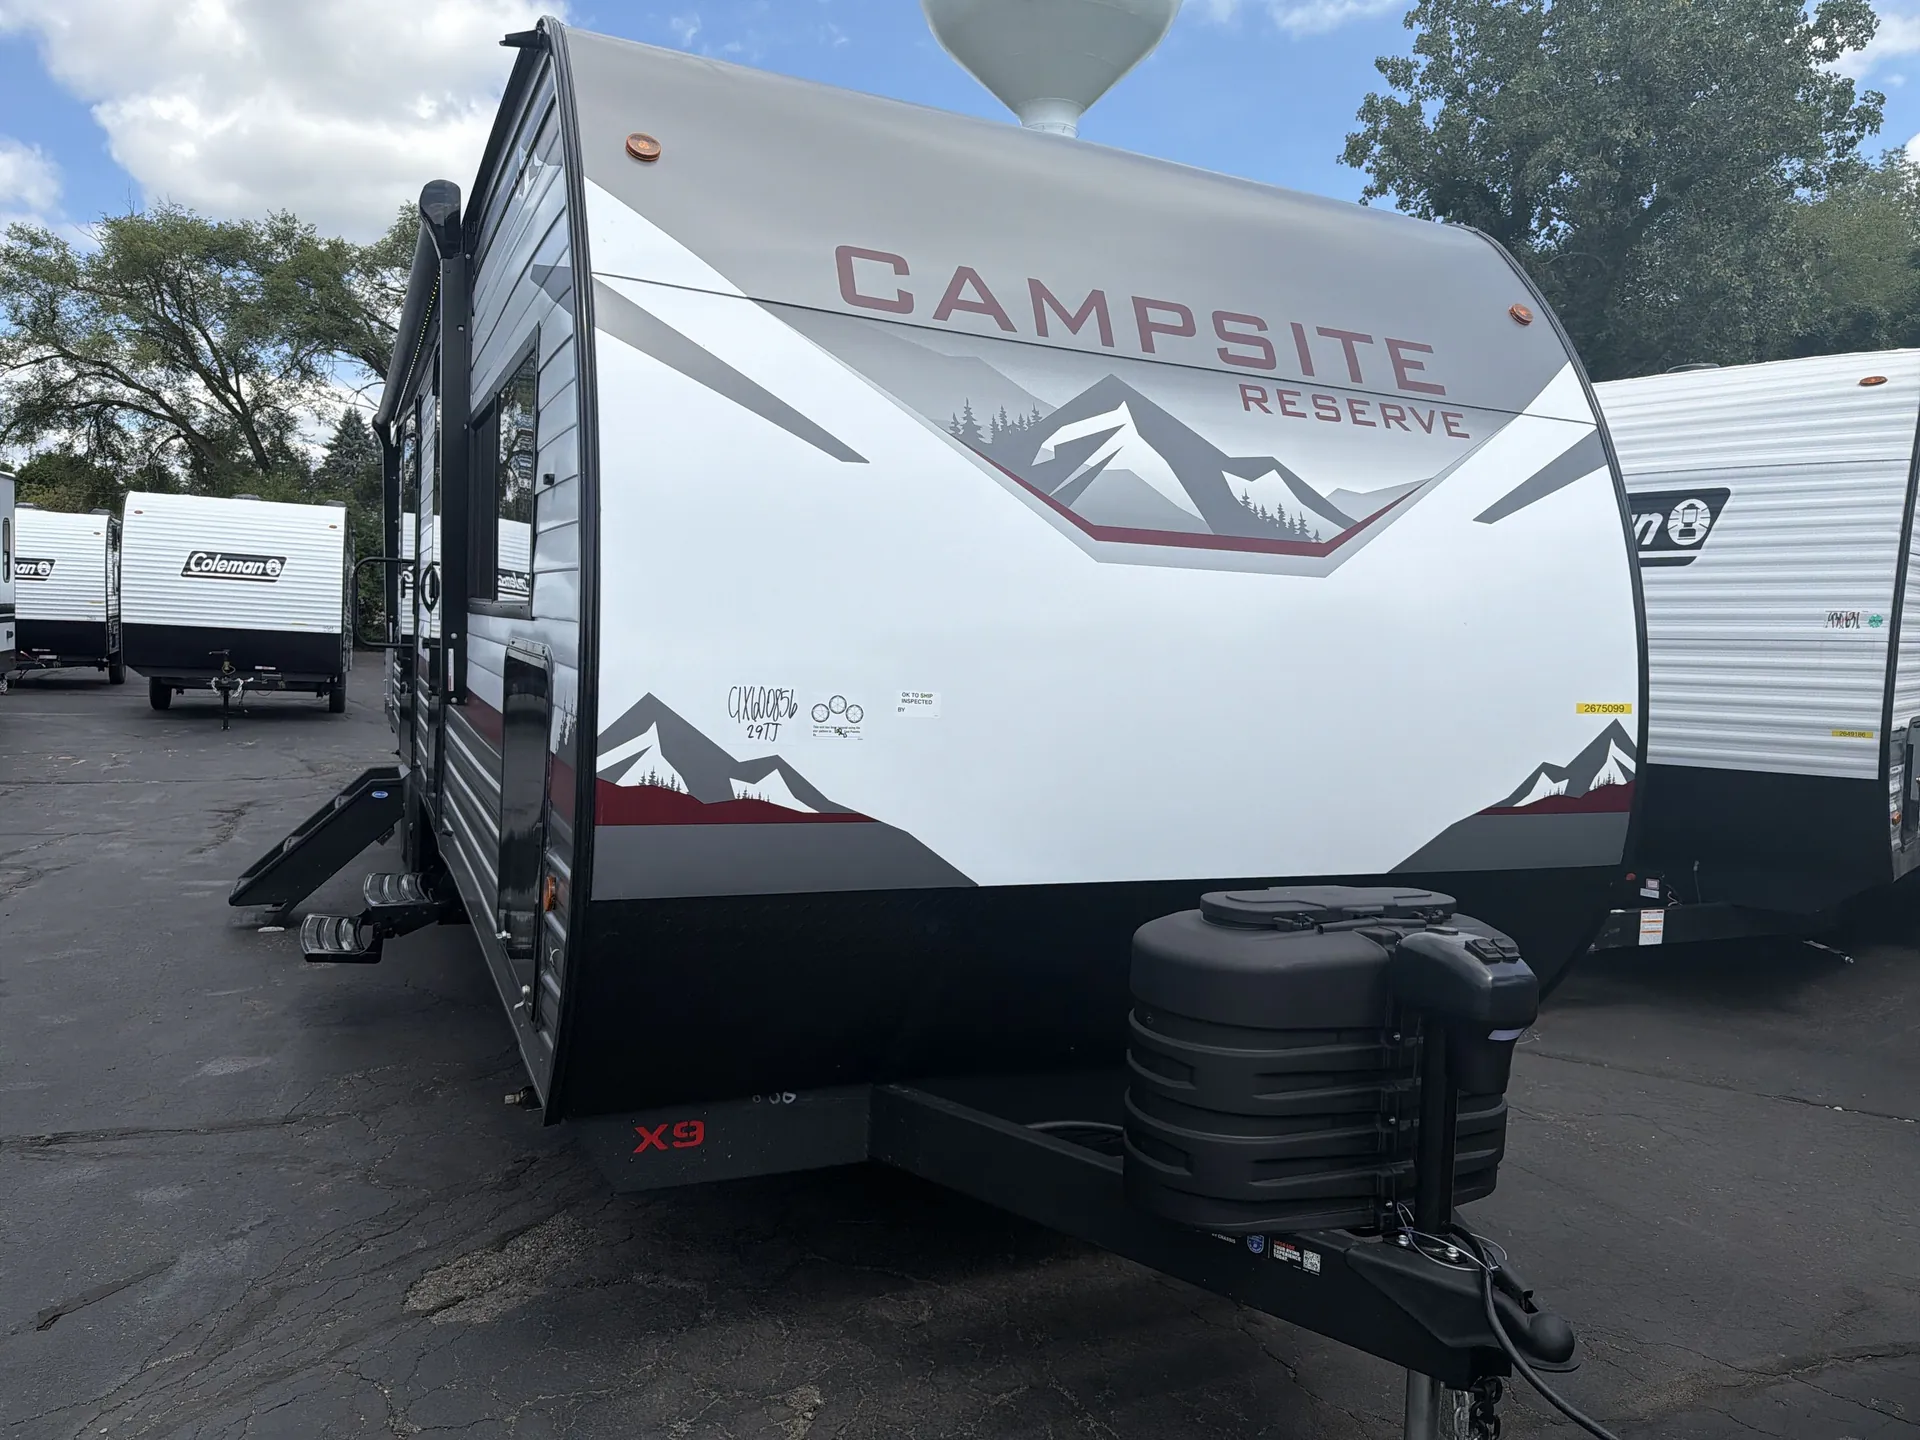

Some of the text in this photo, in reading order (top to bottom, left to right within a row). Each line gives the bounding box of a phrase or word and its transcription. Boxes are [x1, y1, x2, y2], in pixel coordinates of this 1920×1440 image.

[835, 245, 1446, 396] CAMPSITE
[1239, 383, 1471, 439] RESERVE
[189, 552, 265, 577] Coleman
[1584, 703, 1625, 713] 2675099
[633, 1120, 705, 1154] X9
